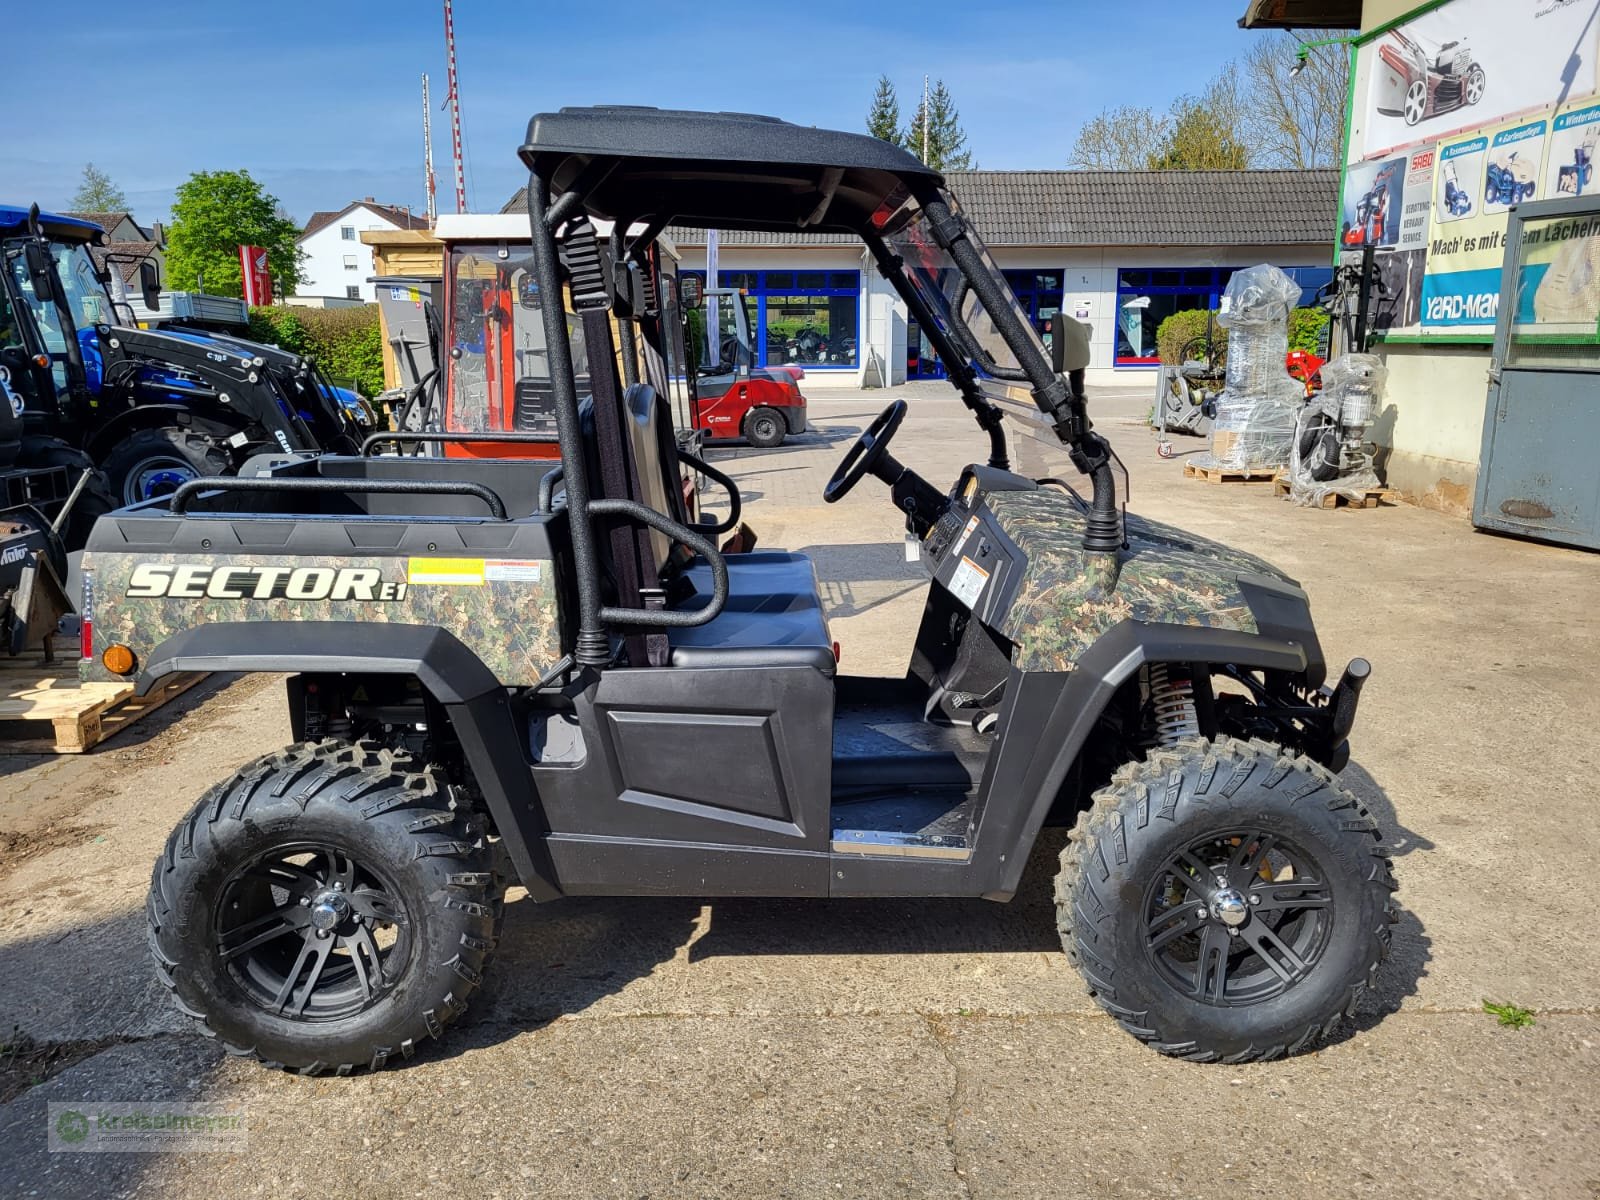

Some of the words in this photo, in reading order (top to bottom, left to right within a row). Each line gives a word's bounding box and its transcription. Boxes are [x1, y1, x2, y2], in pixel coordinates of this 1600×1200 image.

[1412, 152, 1433, 170] SABO
[1402, 232, 1421, 243] SERVICE
[1464, 237, 1476, 252] es
[1478, 231, 1499, 250] mit
[126, 563, 381, 601] SECTOR
[379, 582, 409, 602] E1
